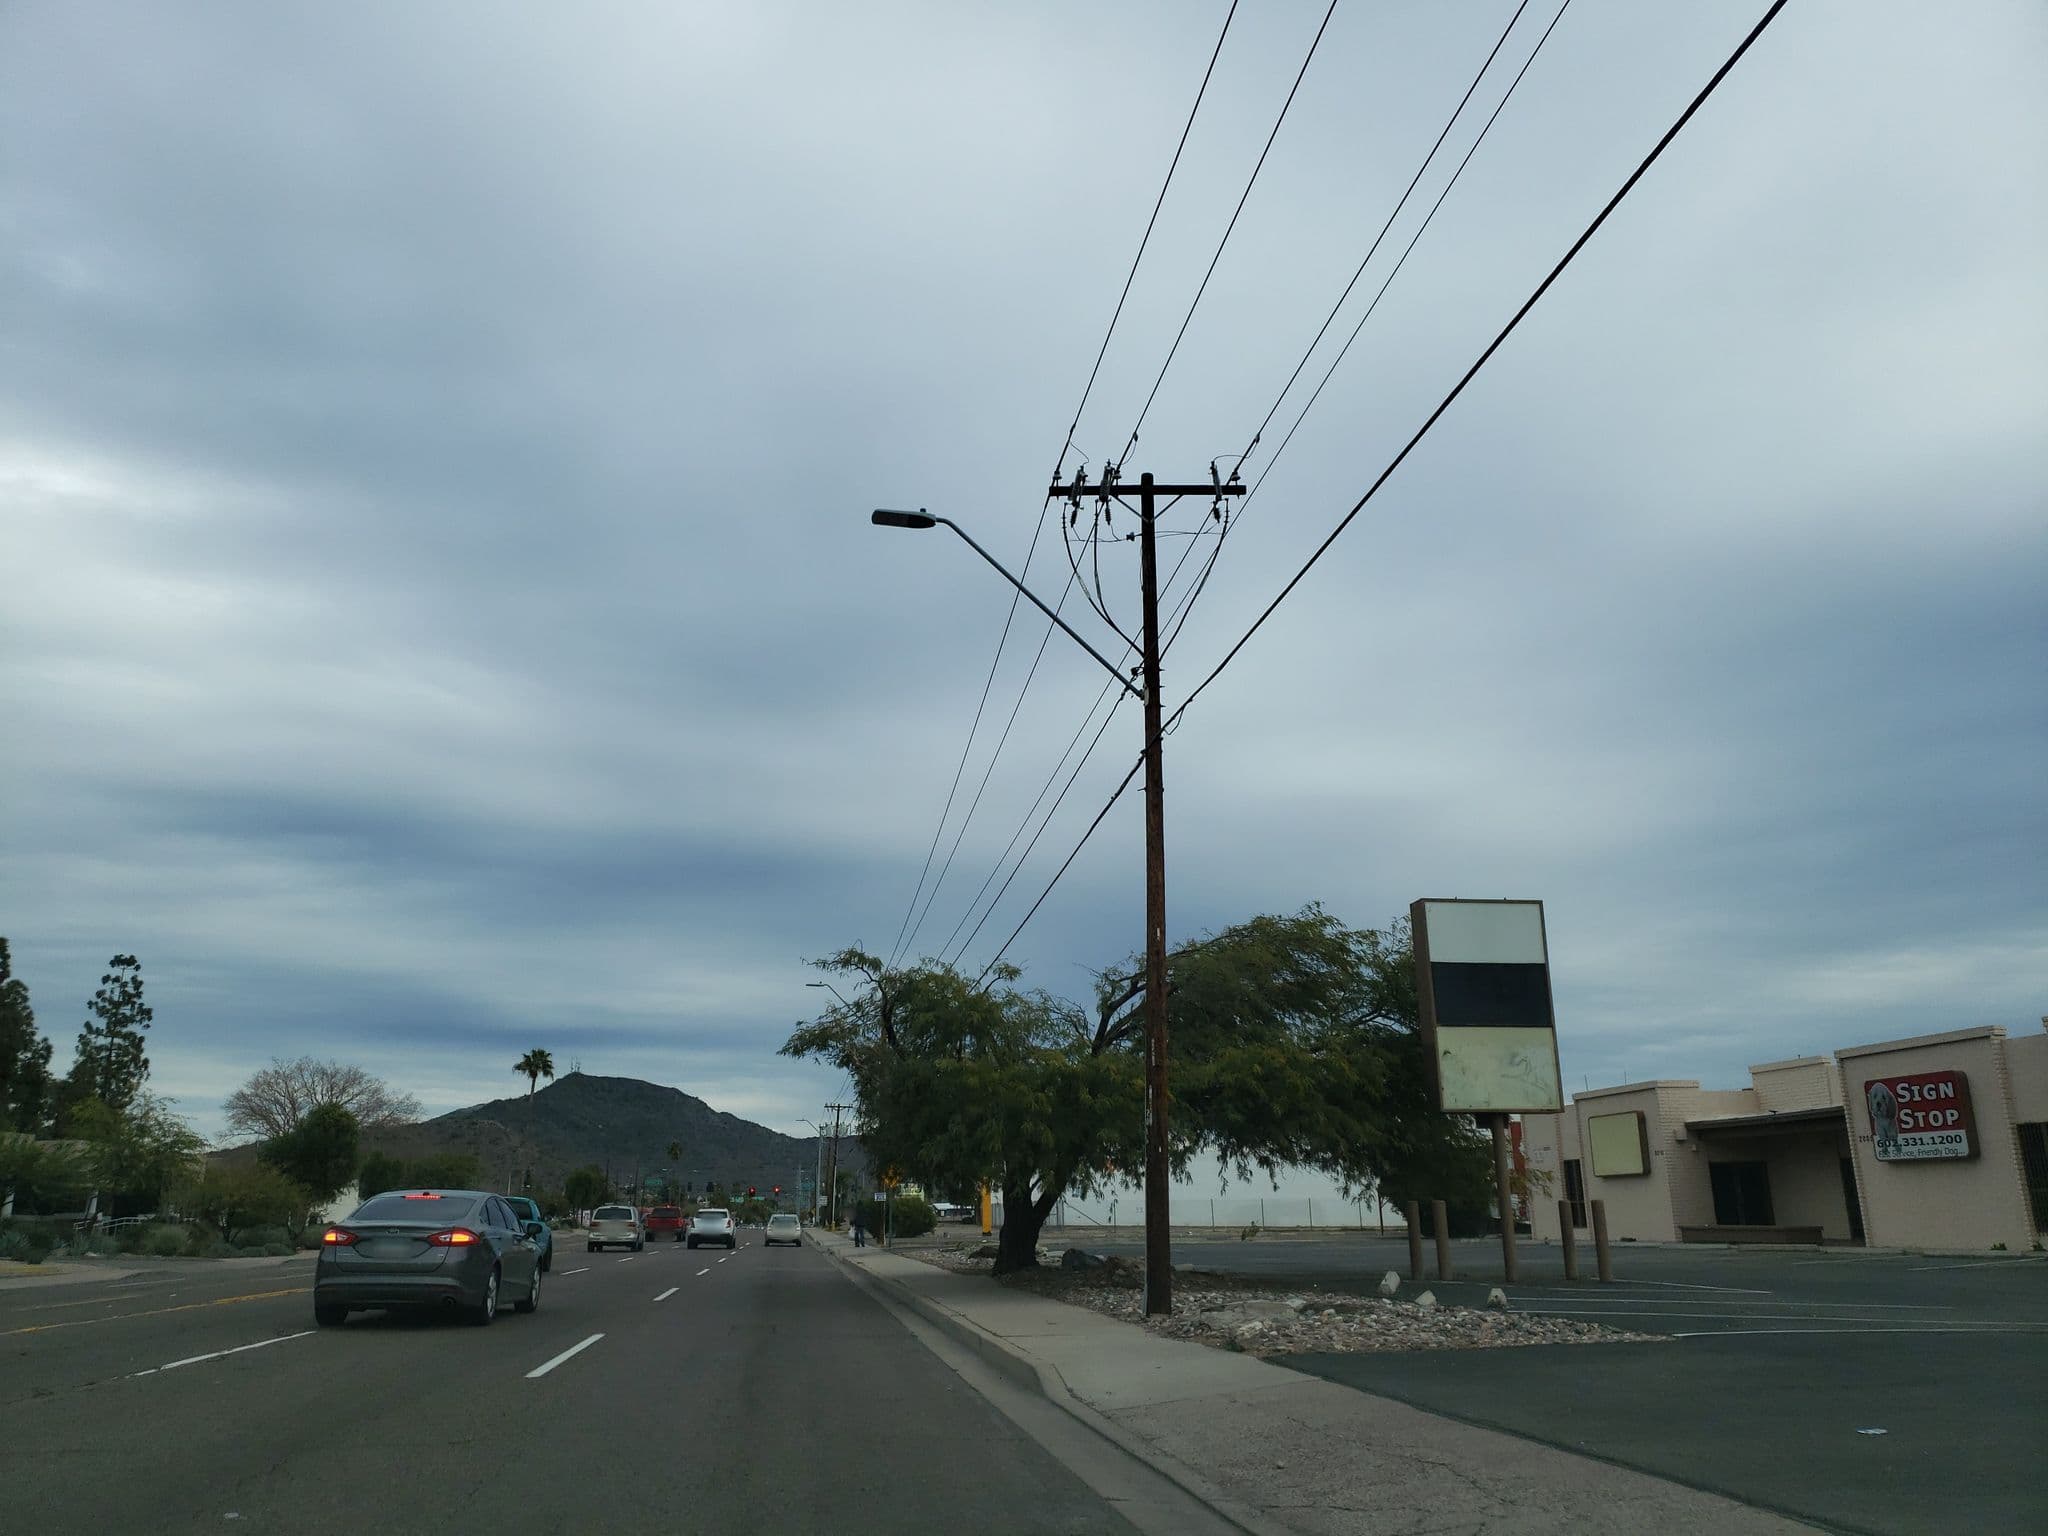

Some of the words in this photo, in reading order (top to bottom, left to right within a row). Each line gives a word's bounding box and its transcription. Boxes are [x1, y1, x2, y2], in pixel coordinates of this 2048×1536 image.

[1896, 1082, 1955, 1103] SIGN
[1899, 1109, 1960, 1129] STOP
[1877, 1135, 1962, 1148] 602.331.1200
